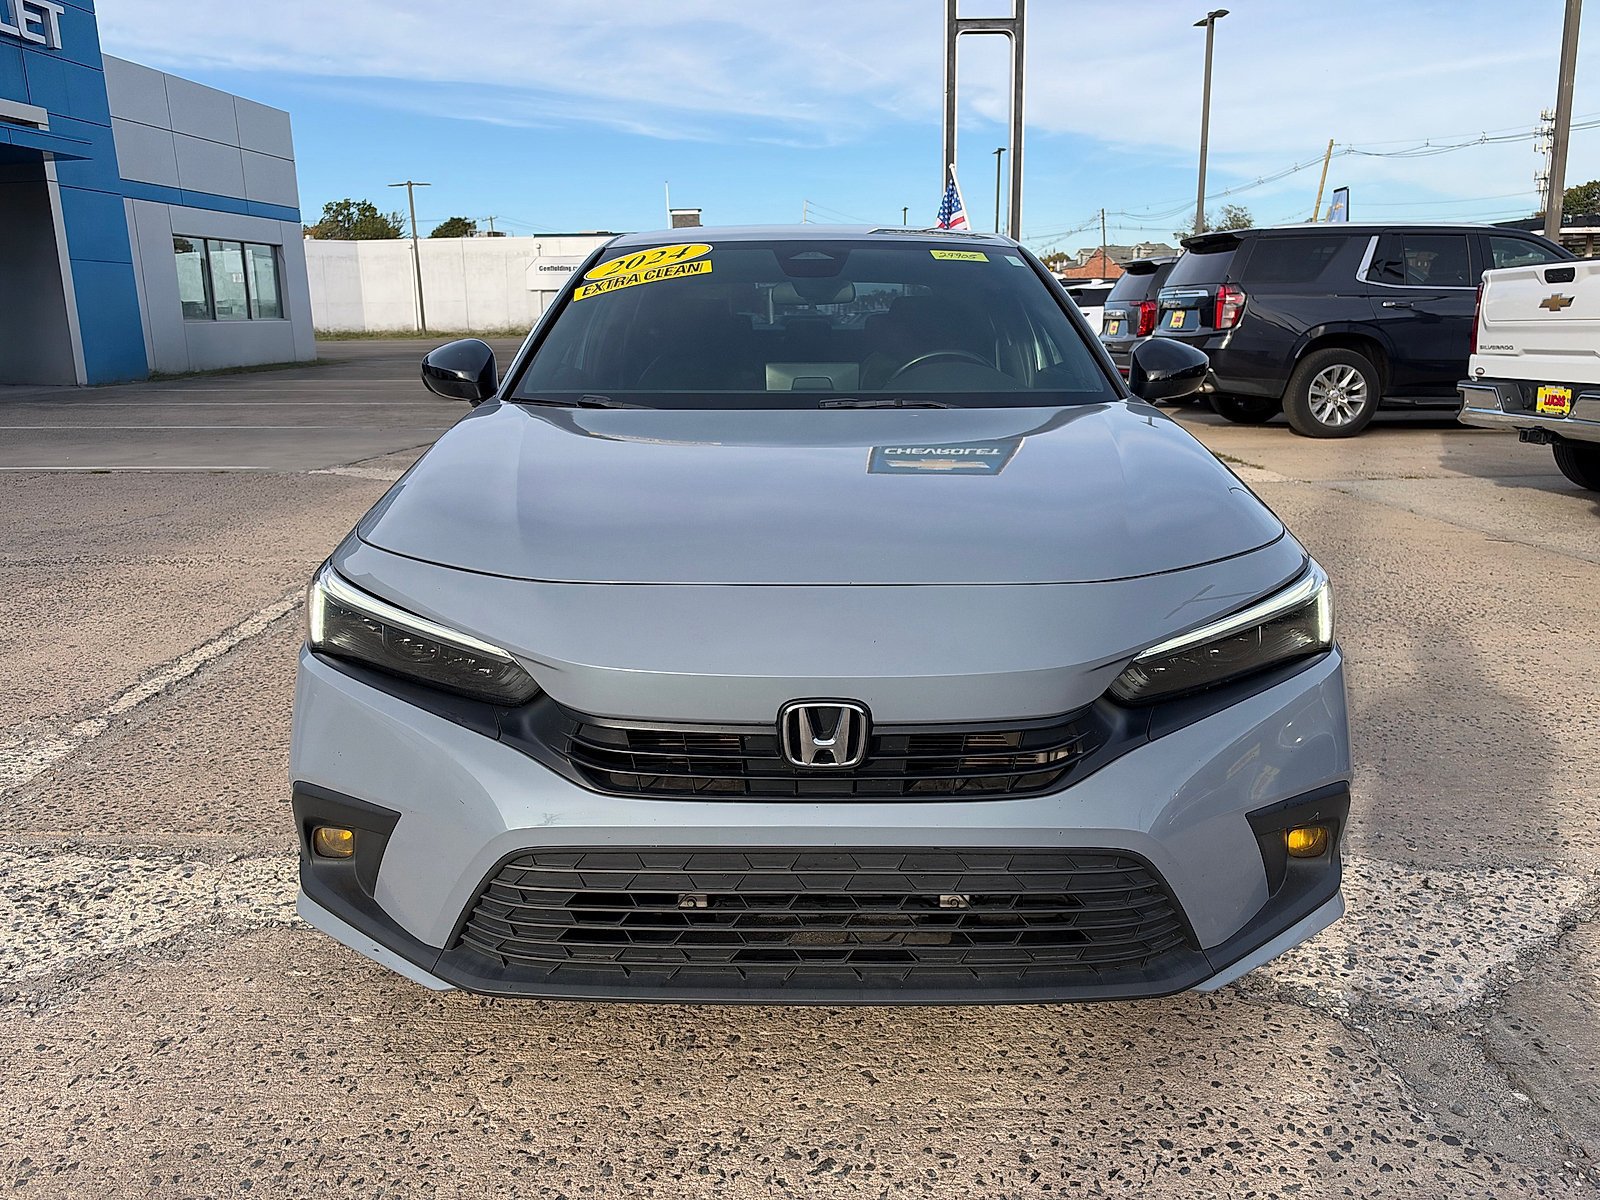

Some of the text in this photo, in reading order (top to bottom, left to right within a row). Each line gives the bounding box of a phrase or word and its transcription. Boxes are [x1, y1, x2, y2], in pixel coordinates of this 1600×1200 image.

[603, 245, 693, 277] 2024
[582, 262, 703, 296] EXTRA CLEAN
